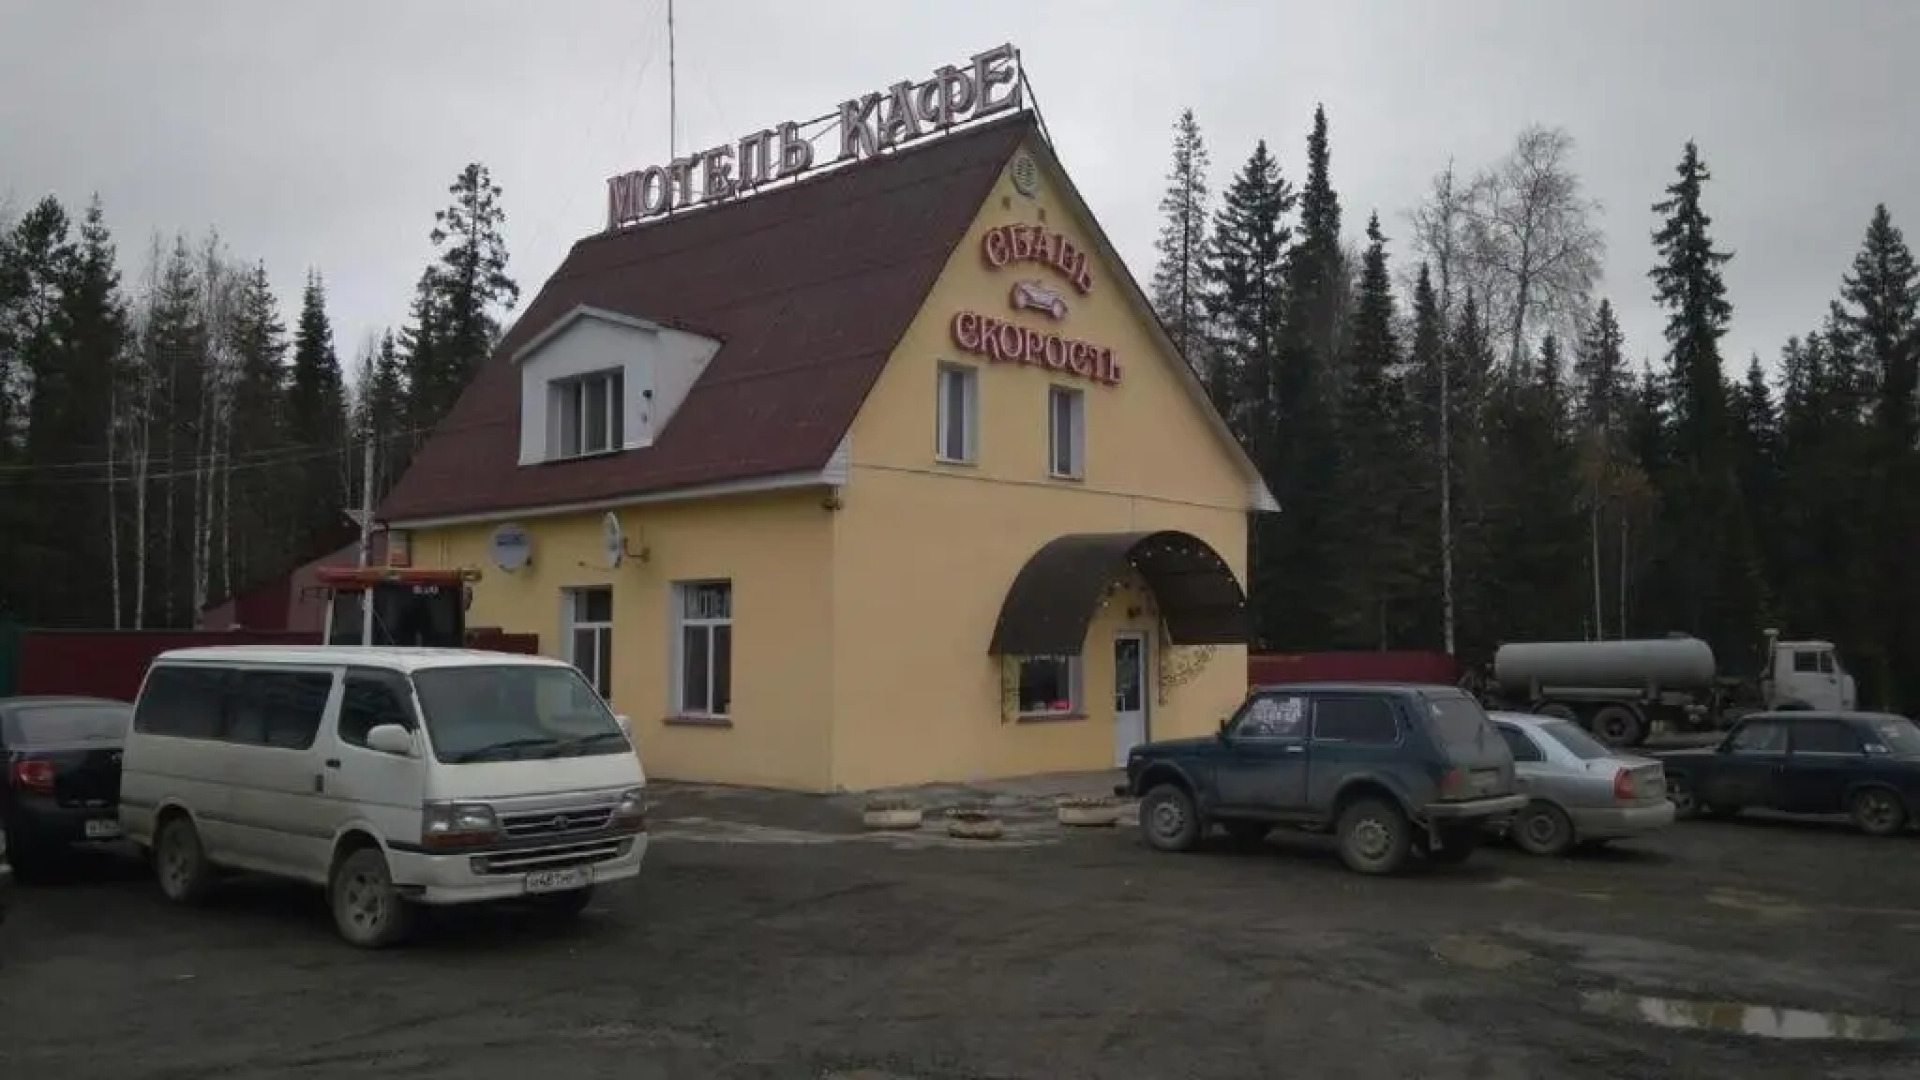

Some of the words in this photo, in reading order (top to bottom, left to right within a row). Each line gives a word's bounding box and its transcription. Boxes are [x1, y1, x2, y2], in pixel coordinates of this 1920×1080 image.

[607, 120, 815, 223] МОТЕЛЬ
[838, 42, 1020, 160] КАФЕ
[982, 222, 1093, 294] СБАВЬ
[952, 309, 1122, 387] СКОРОСТЬ
